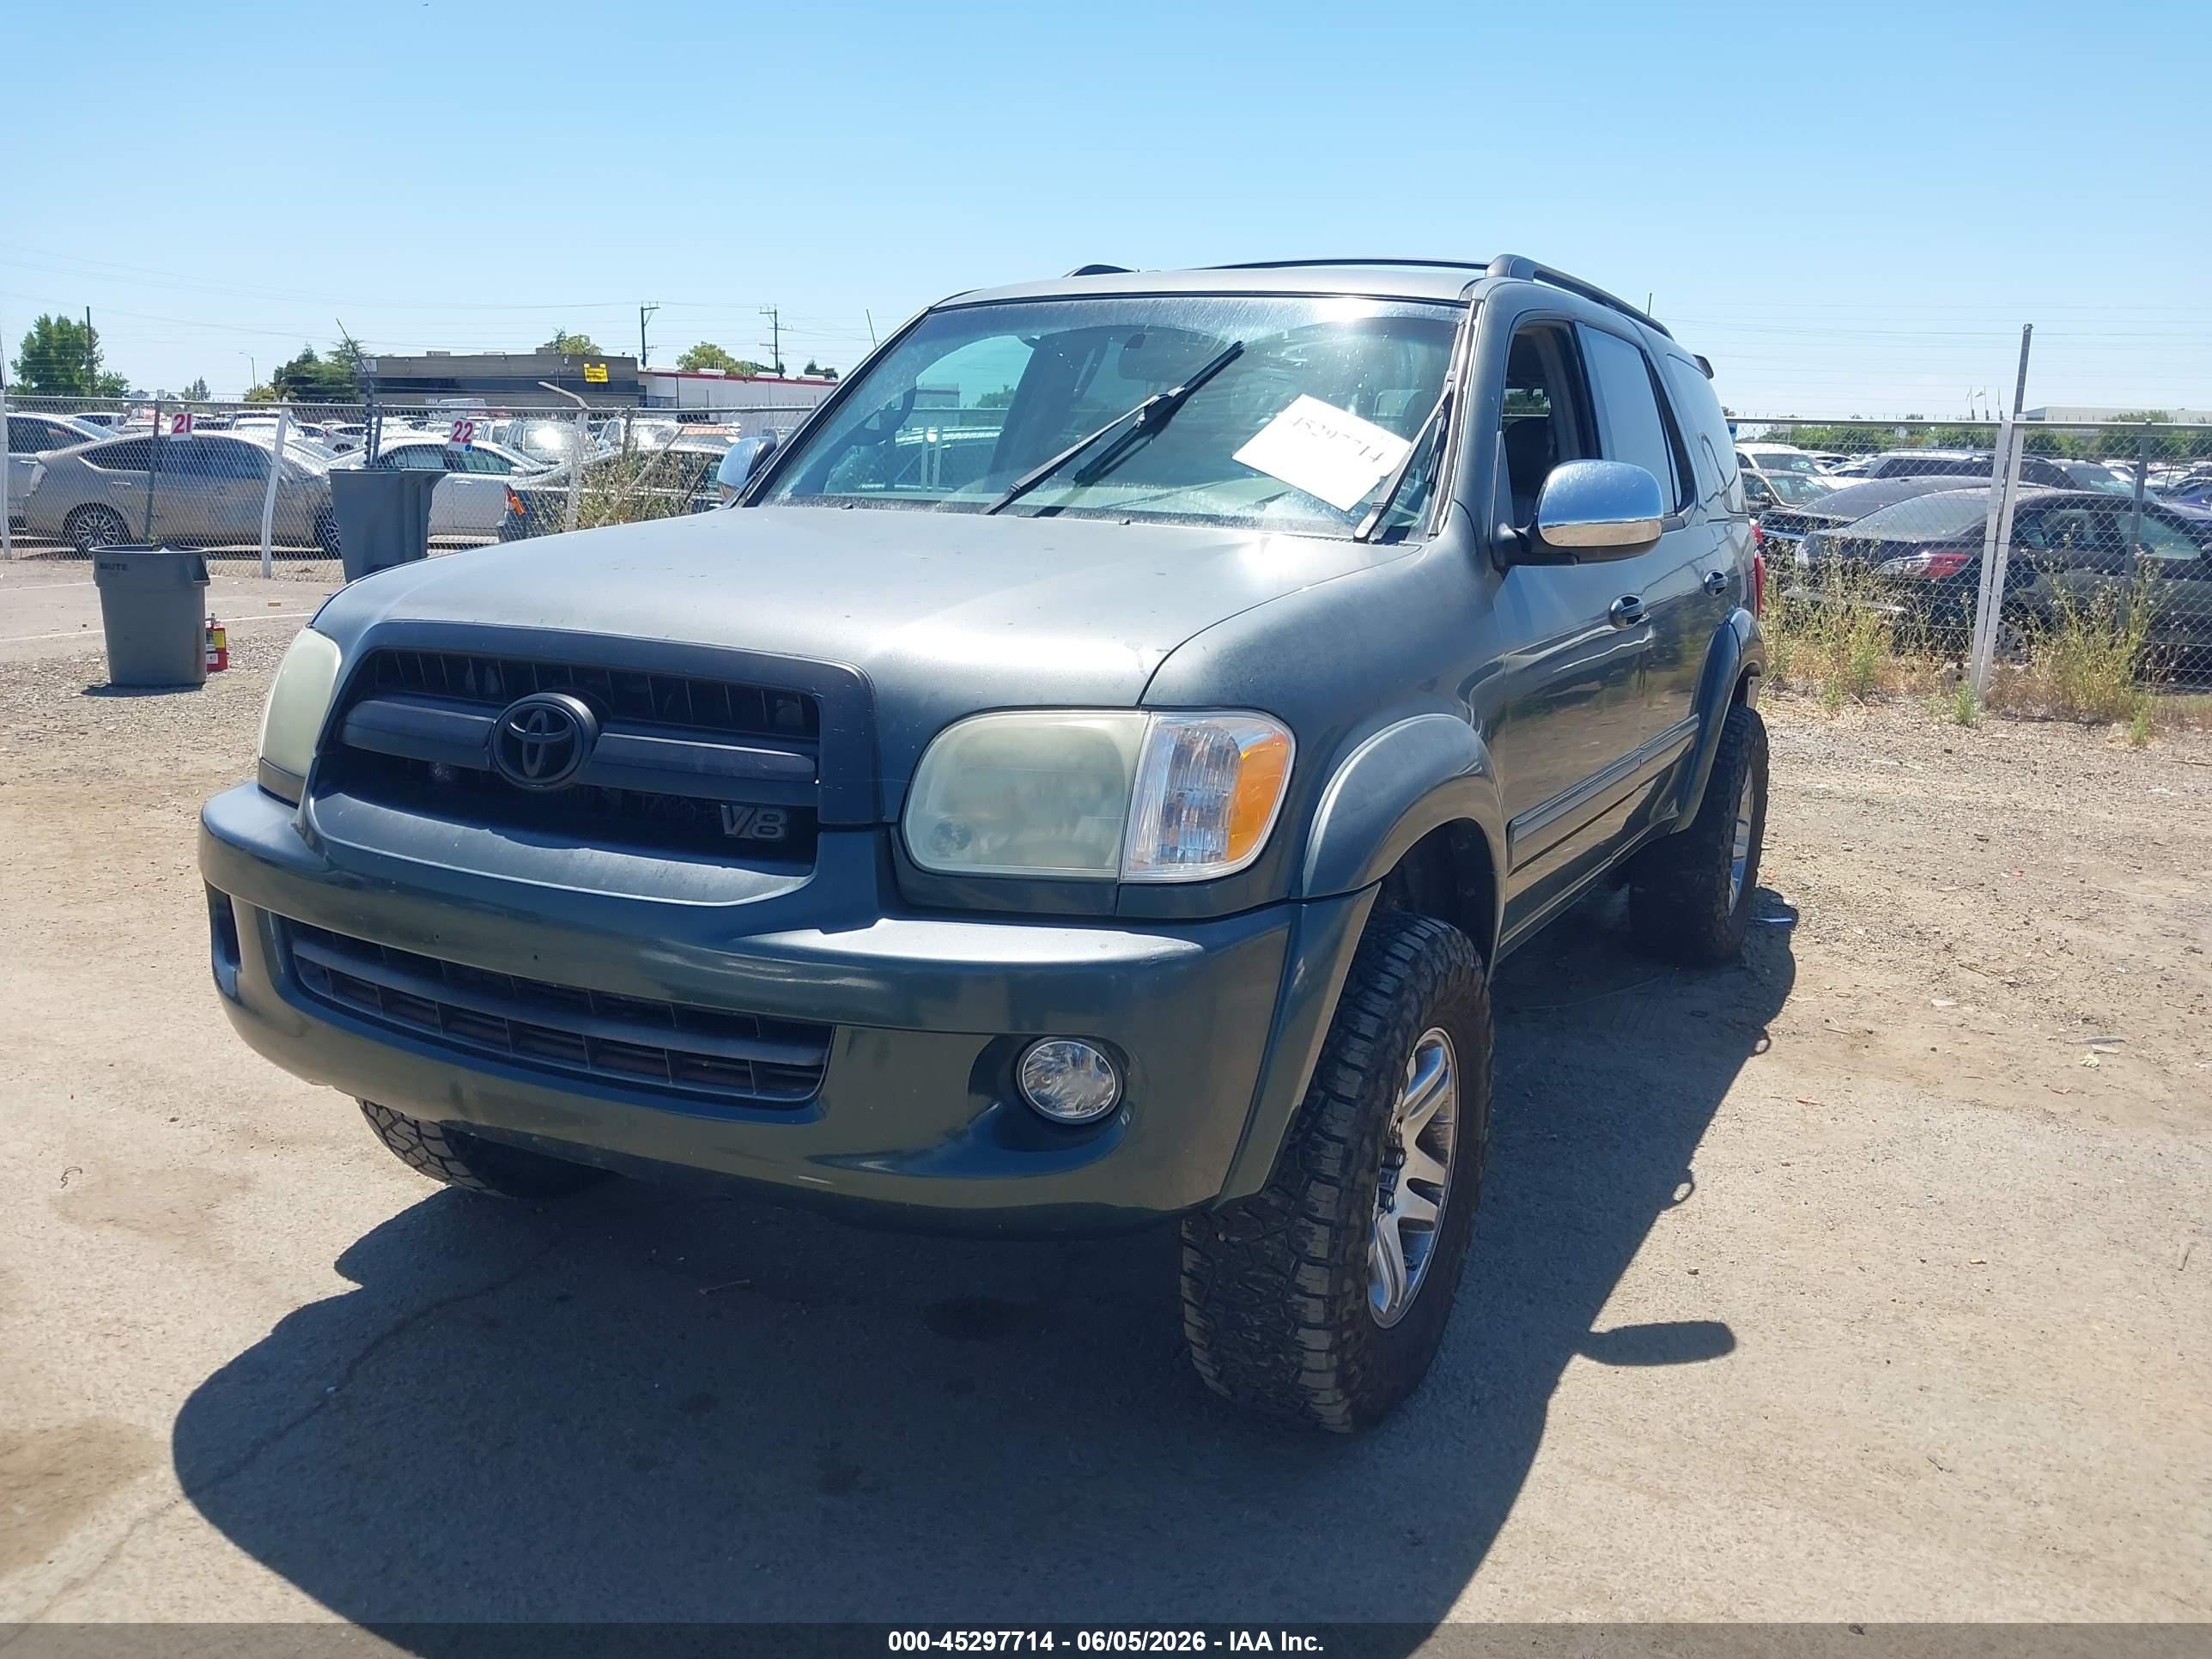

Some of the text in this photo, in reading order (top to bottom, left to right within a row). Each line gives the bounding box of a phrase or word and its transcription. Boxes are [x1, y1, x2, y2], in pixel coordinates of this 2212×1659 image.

[172, 413, 192, 434] 21
[452, 420, 474, 443] 22
[720, 804, 789, 840] V8
